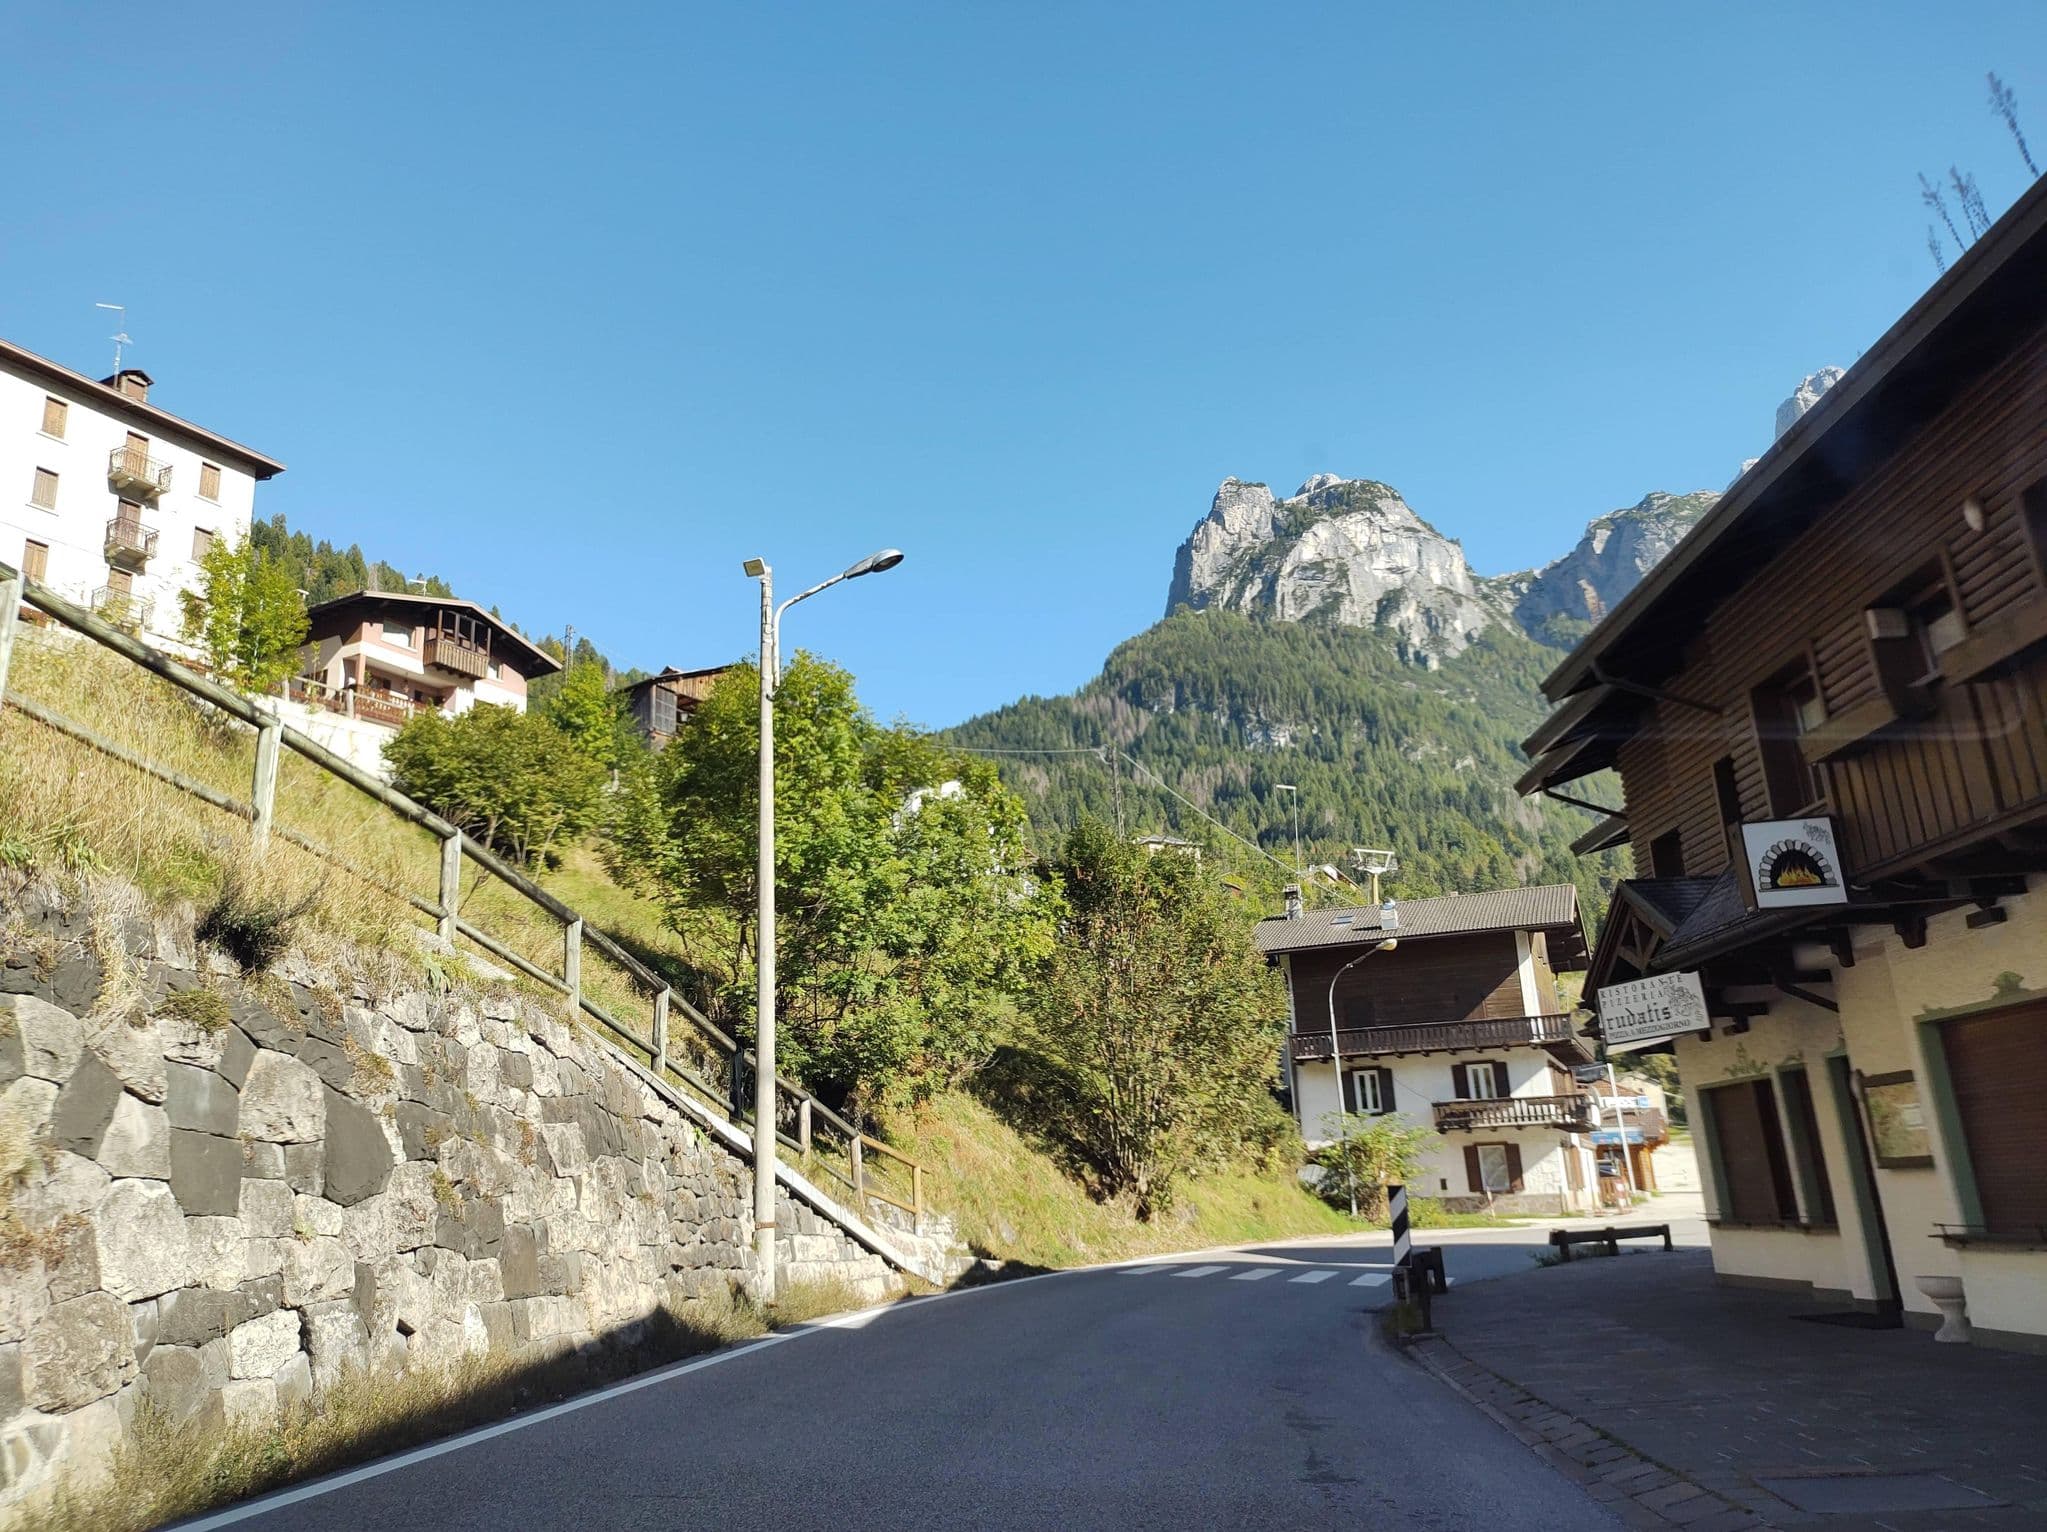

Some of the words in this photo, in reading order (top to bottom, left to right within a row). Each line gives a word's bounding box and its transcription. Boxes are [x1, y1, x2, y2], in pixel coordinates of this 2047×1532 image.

[1600, 974, 1684, 998] RISTORANTE
[1602, 990, 1664, 1009] PIZZERIA
[1606, 1002, 1672, 1030] rudatis
[1636, 1019, 1691, 1035] MEZZOGIORNO
